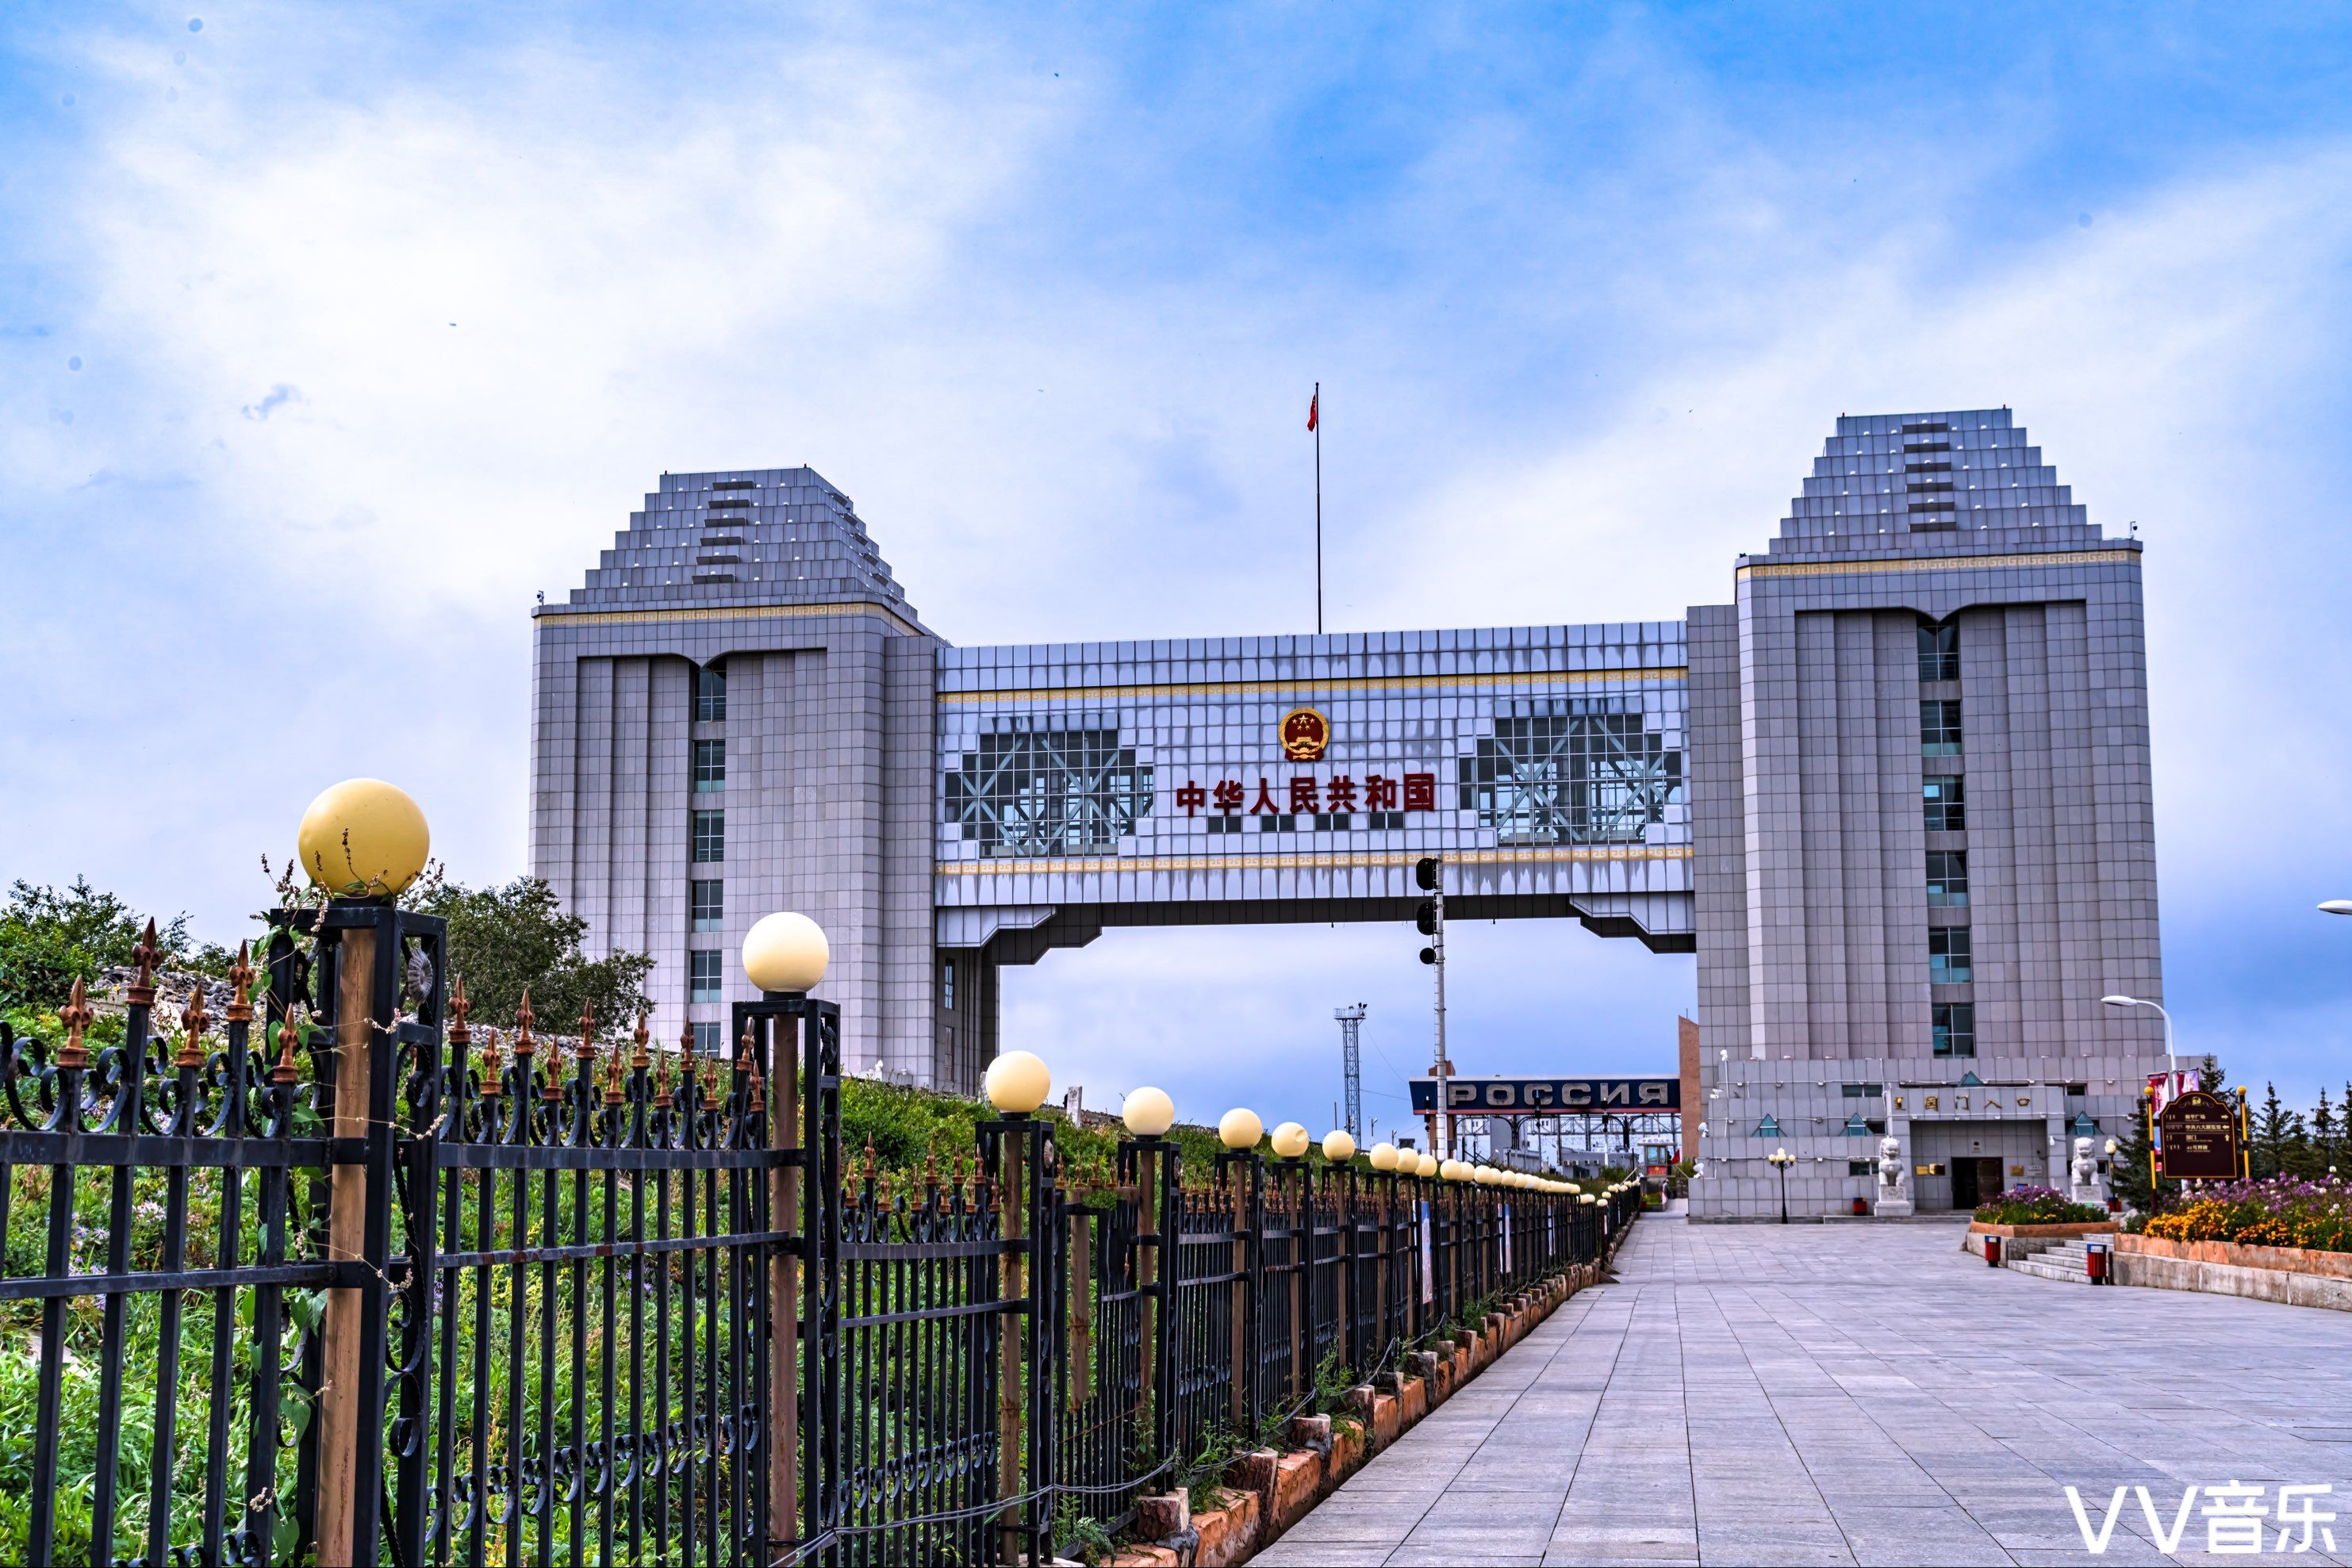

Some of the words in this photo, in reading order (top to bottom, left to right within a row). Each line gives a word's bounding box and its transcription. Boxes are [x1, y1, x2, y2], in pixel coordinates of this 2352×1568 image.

[1176, 773, 1434, 818] 中华人民共和国
[1448, 1083, 1668, 1106] РОССИЯ
